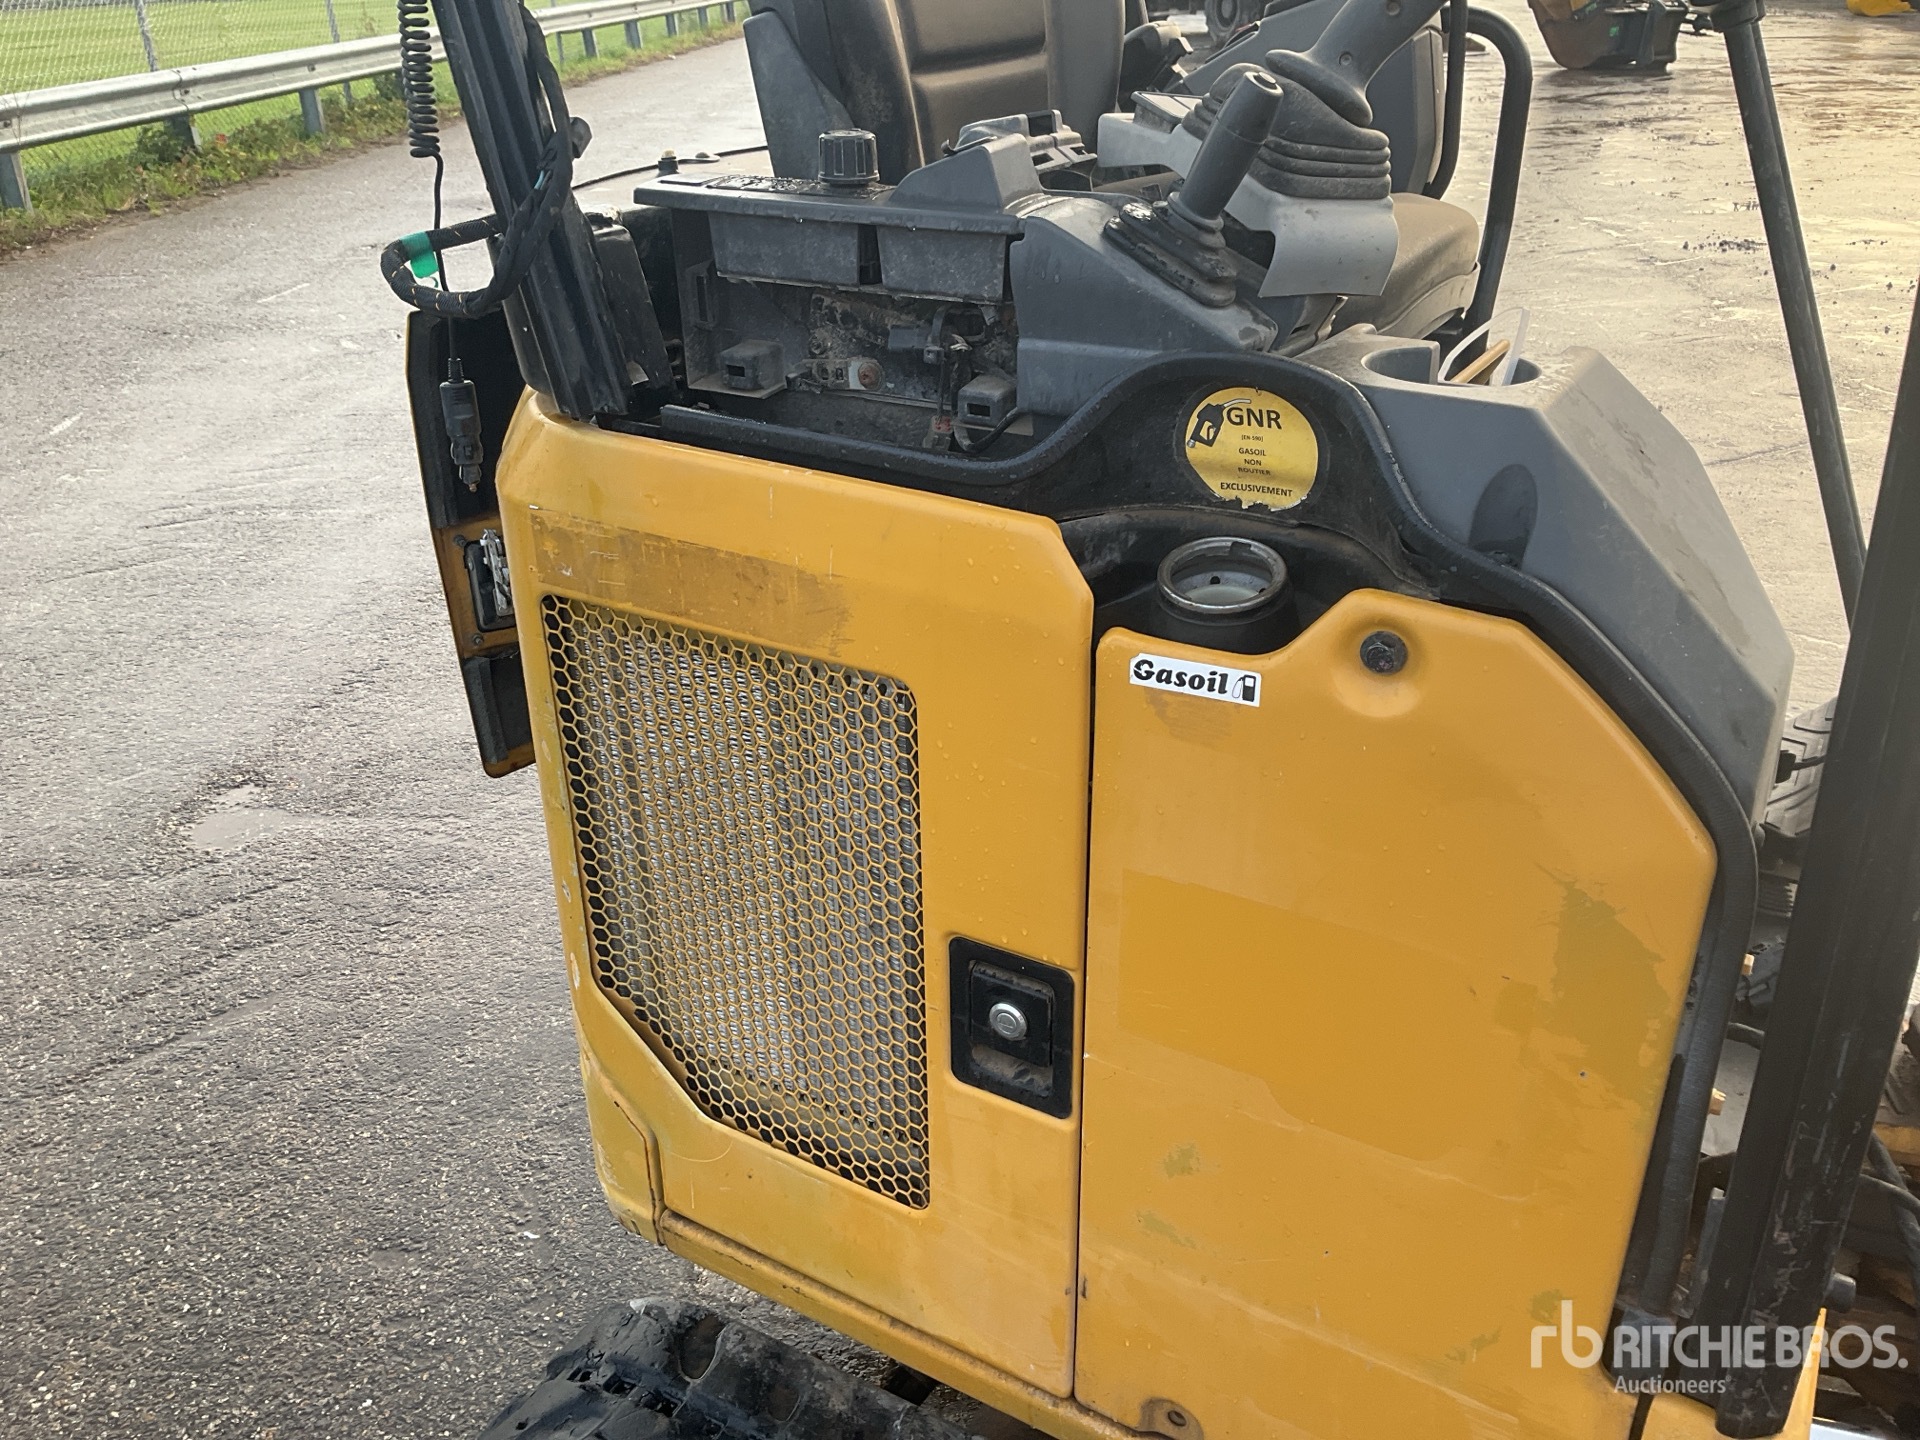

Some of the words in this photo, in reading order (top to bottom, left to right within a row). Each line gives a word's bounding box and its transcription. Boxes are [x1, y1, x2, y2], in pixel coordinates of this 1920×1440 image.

[1226, 407, 1282, 429] GNR
[1238, 447, 1266, 456] GASOIL
[1244, 458, 1262, 466] NON
[1238, 467, 1271, 475] ROUTIER
[1220, 482, 1293, 497] EXCLUSIVEMENT
[1133, 659, 1229, 694] Gasoil
